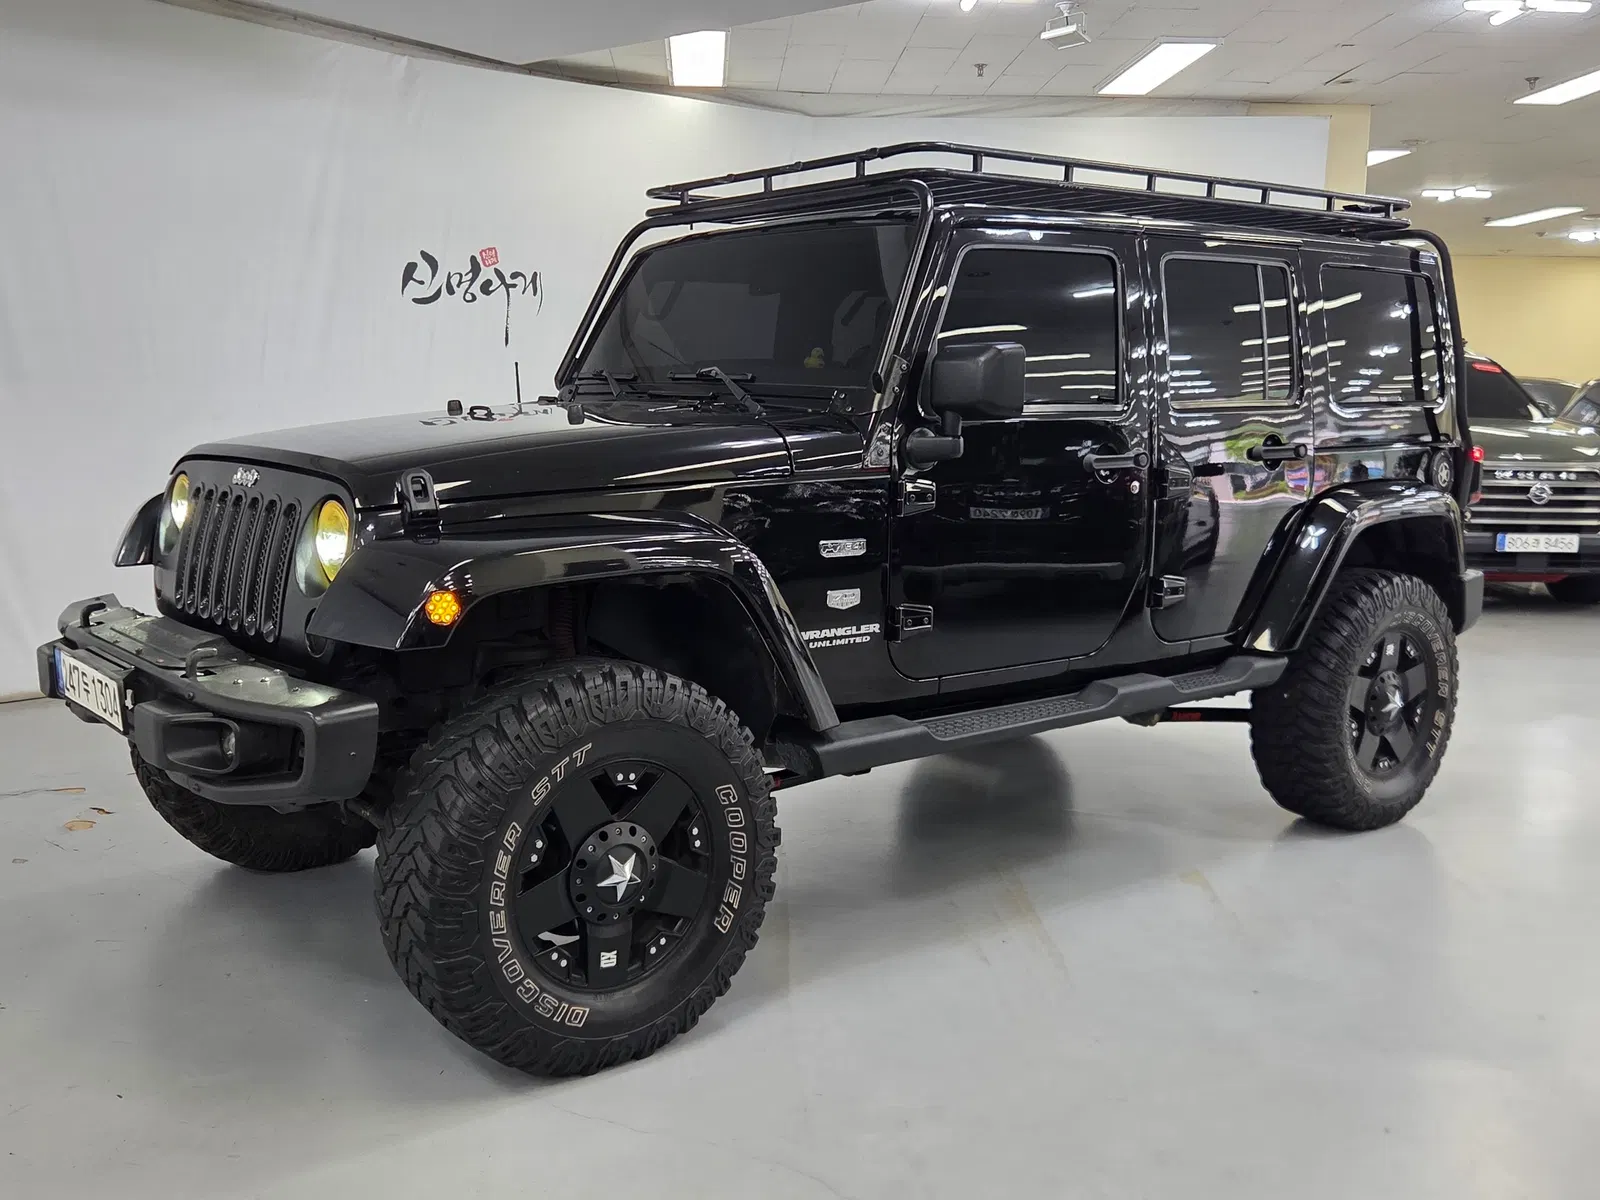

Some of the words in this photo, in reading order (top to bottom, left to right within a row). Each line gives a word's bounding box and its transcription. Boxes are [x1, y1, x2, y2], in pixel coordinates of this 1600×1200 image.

[809, 636, 871, 649] UNLIMITED
[530, 743, 592, 806] STT
[714, 783, 748, 934] COOPER
[489, 821, 591, 1028] DISCOVERER
